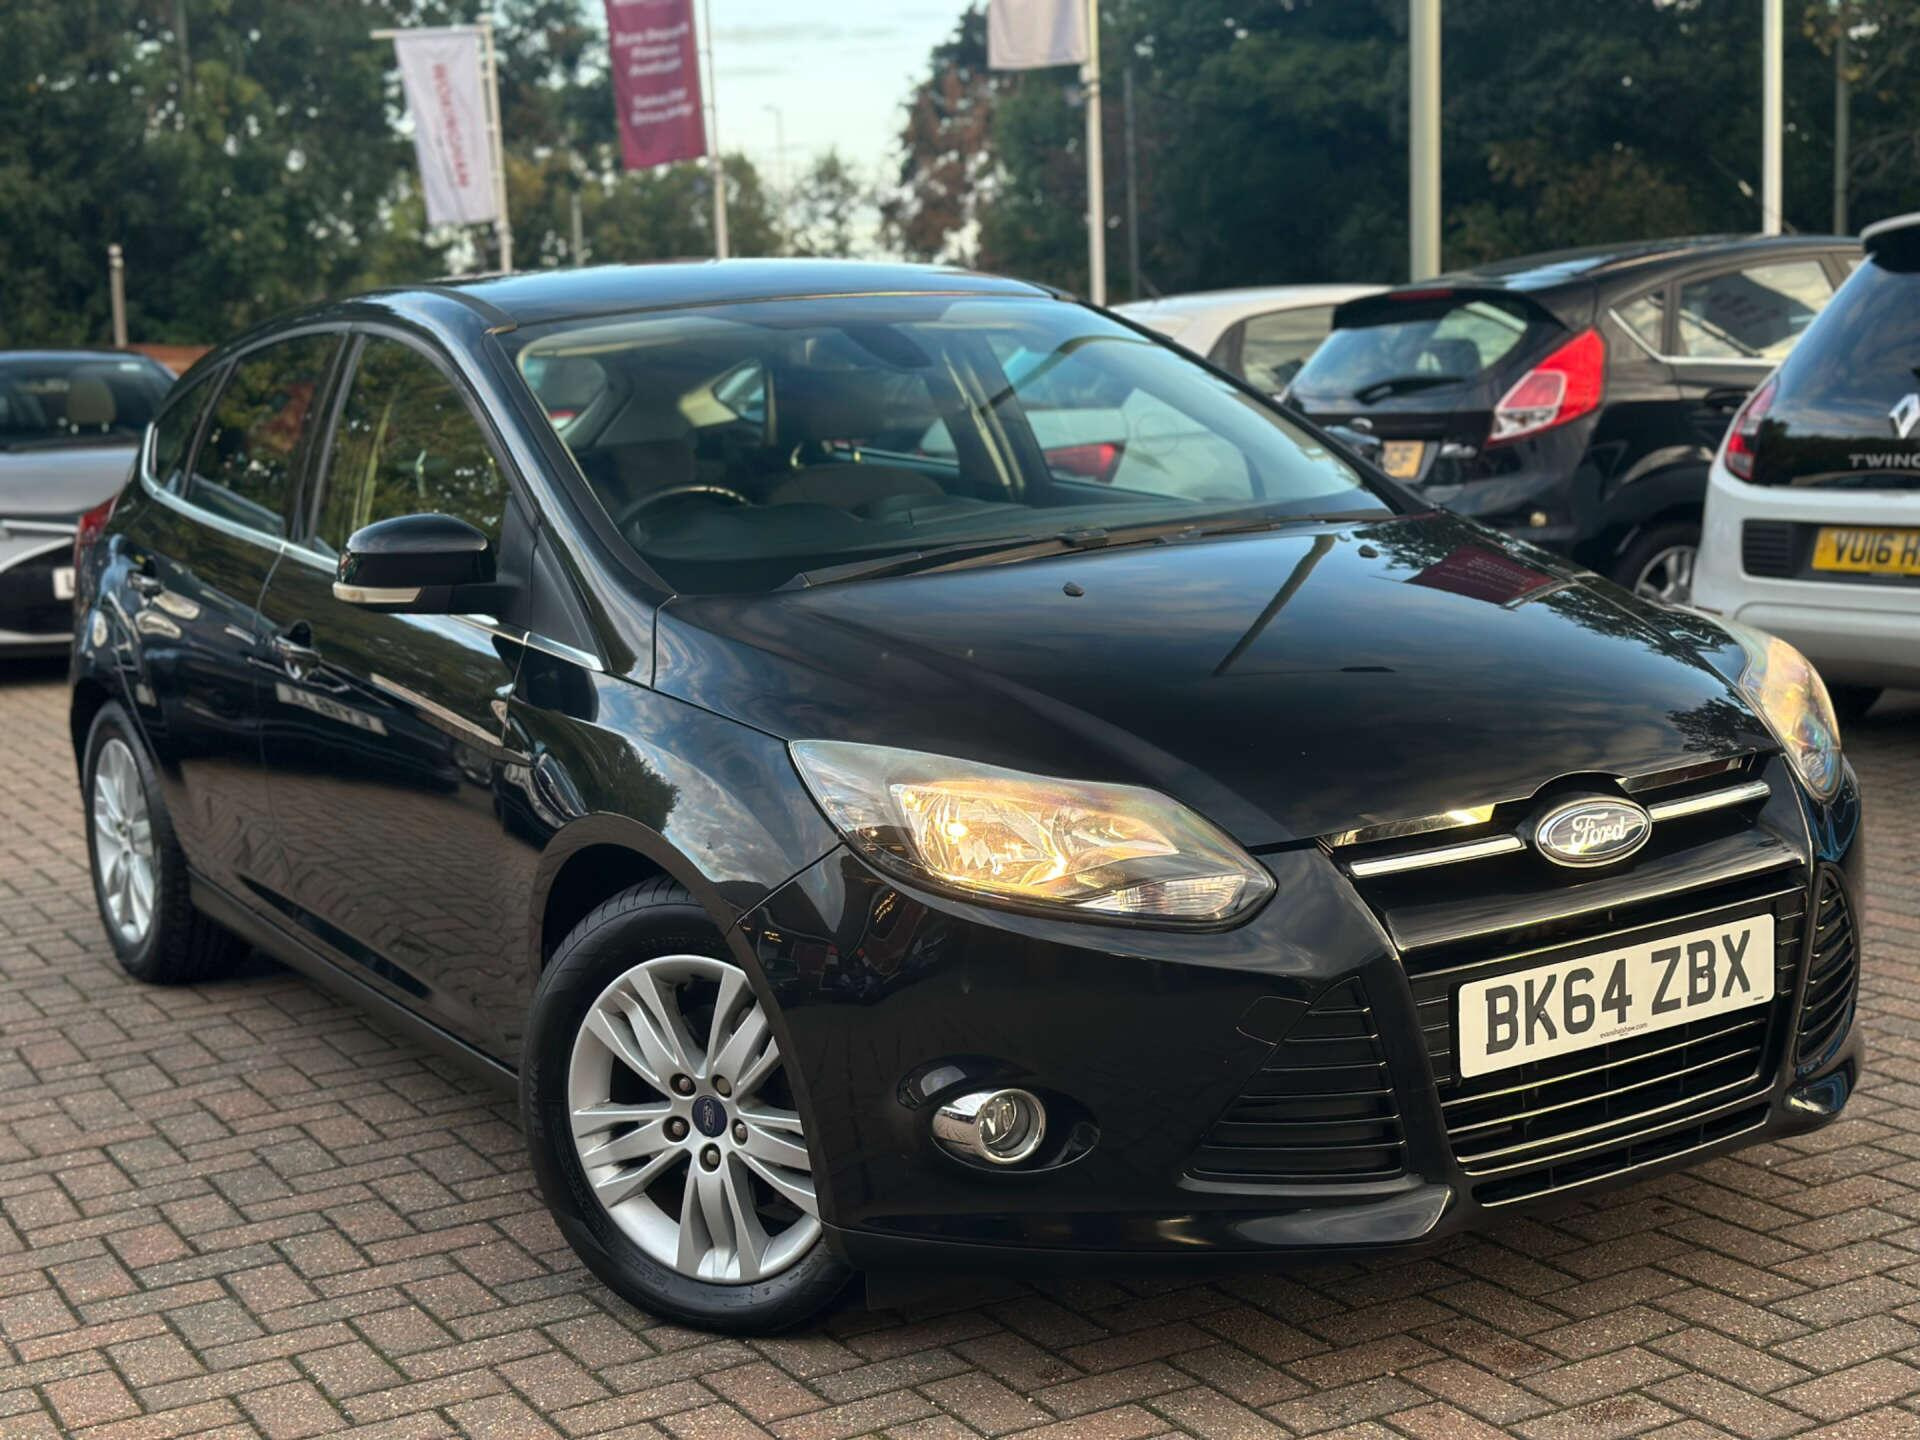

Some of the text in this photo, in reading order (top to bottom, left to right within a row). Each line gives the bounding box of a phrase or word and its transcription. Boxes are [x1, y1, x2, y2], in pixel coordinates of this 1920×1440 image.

[1835, 531, 1892, 564] VU16
[1570, 812, 1625, 853] Ford
[1486, 929, 1751, 1055] BK64 ZBX
